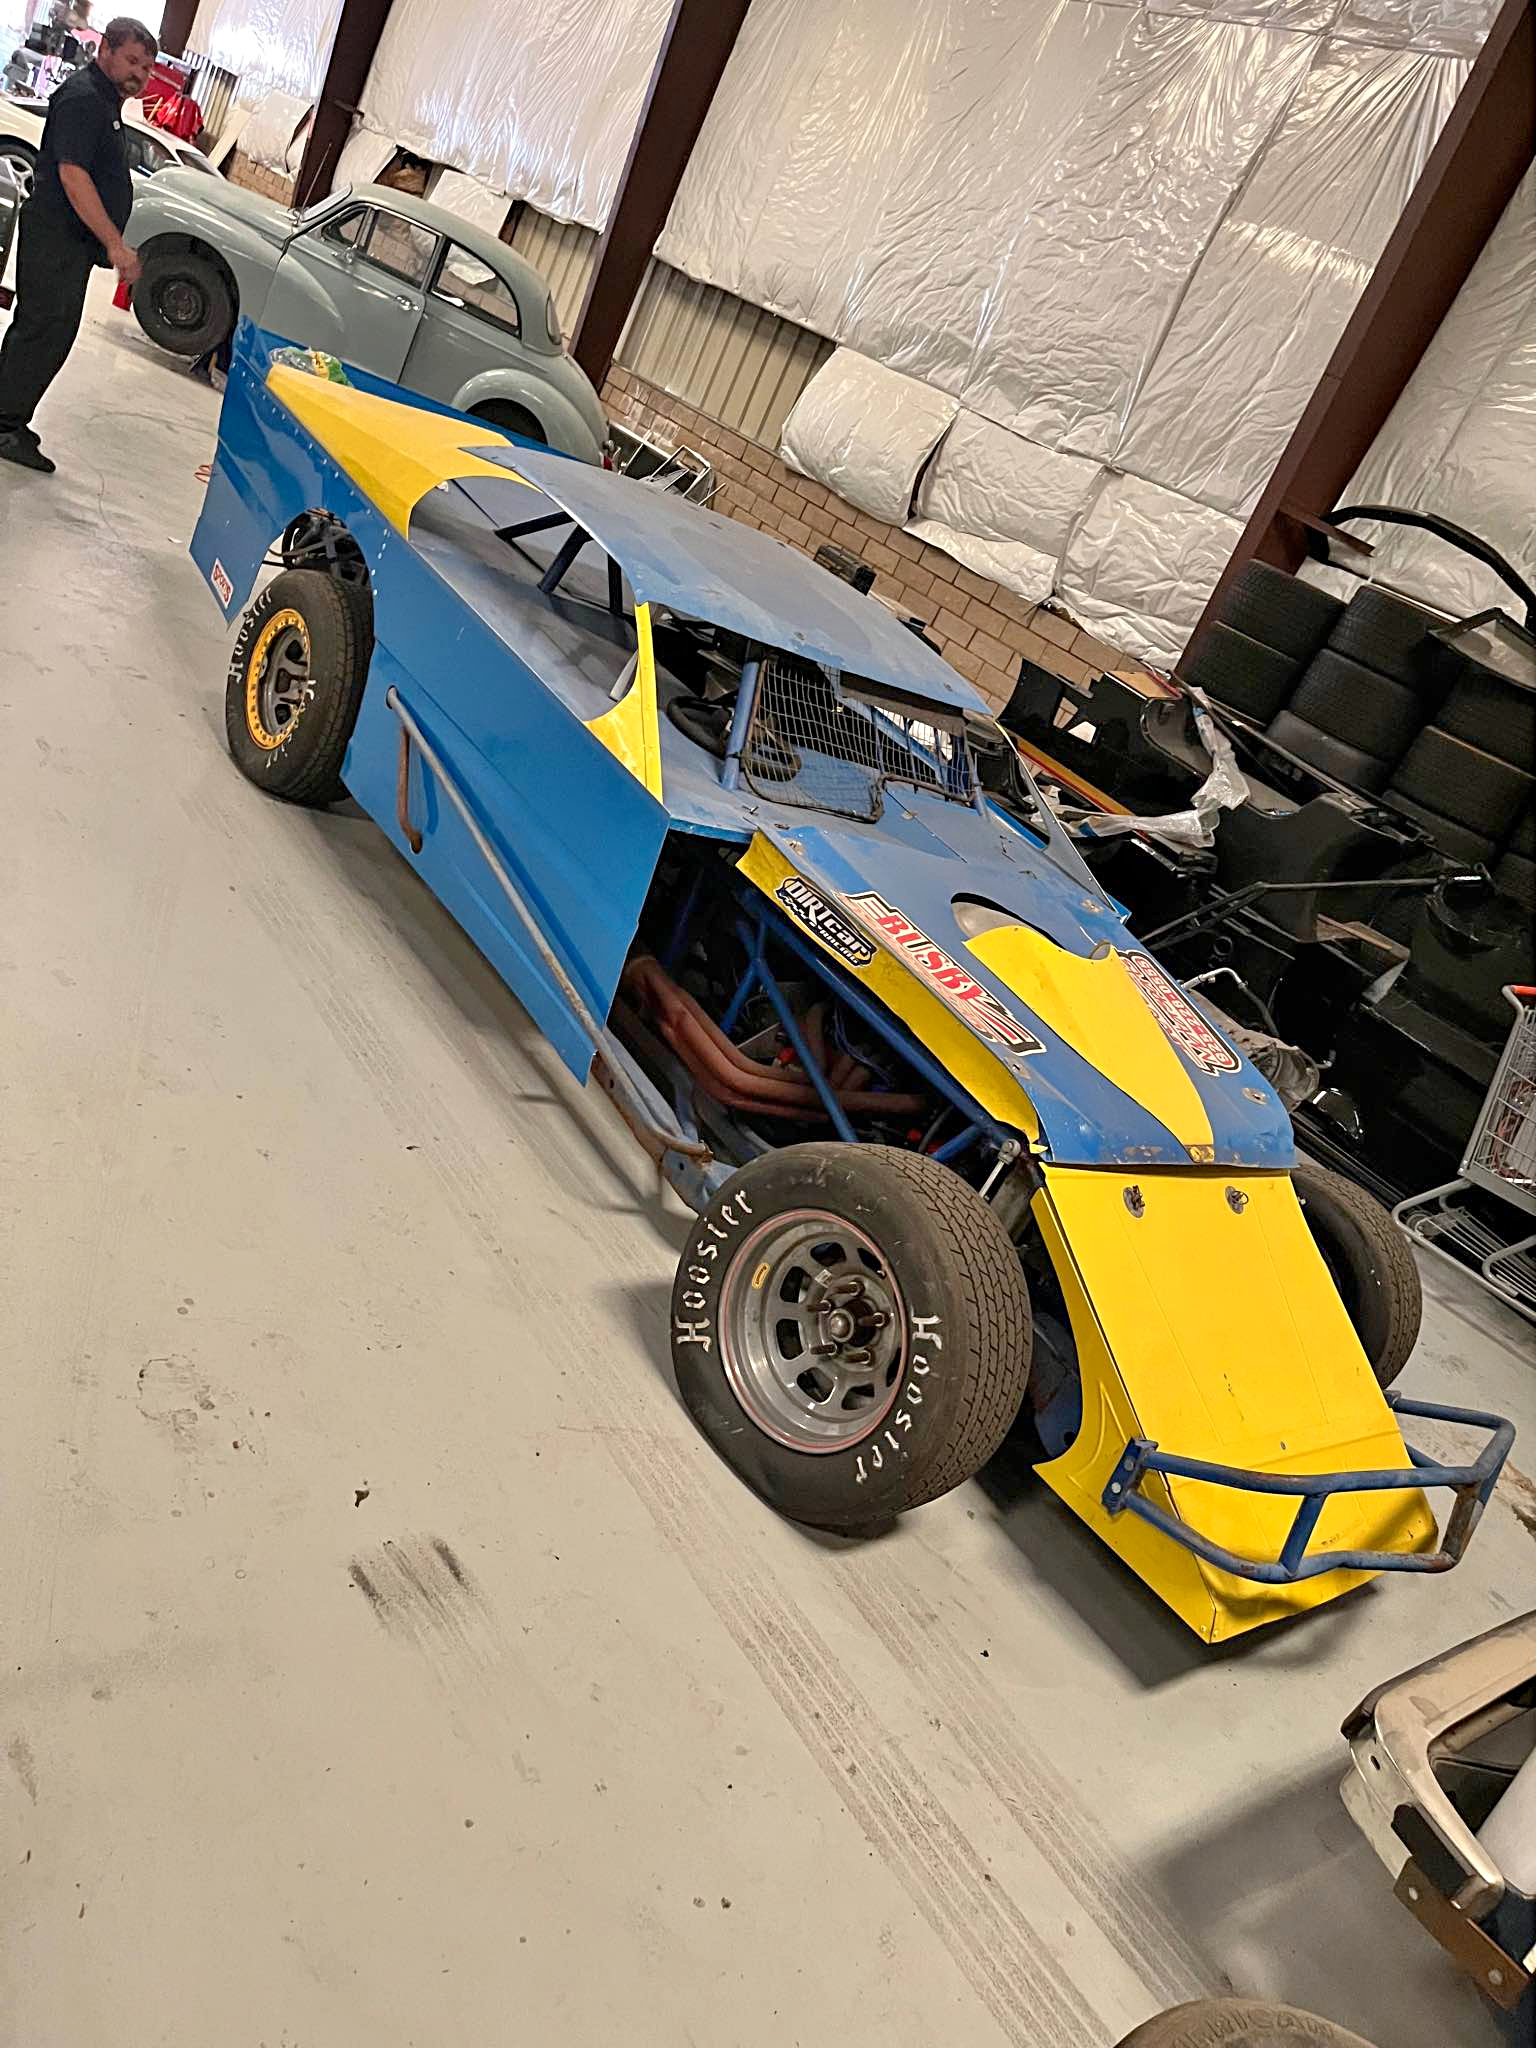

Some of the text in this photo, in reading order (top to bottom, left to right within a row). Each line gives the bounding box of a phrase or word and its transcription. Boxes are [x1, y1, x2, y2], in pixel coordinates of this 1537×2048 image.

[875, 914, 990, 1001] BUSBY
[1136, 957, 1229, 1064] 925-228-0555
[675, 1189, 752, 1352] Hoosier
[855, 1314, 943, 1484] Hoosier
